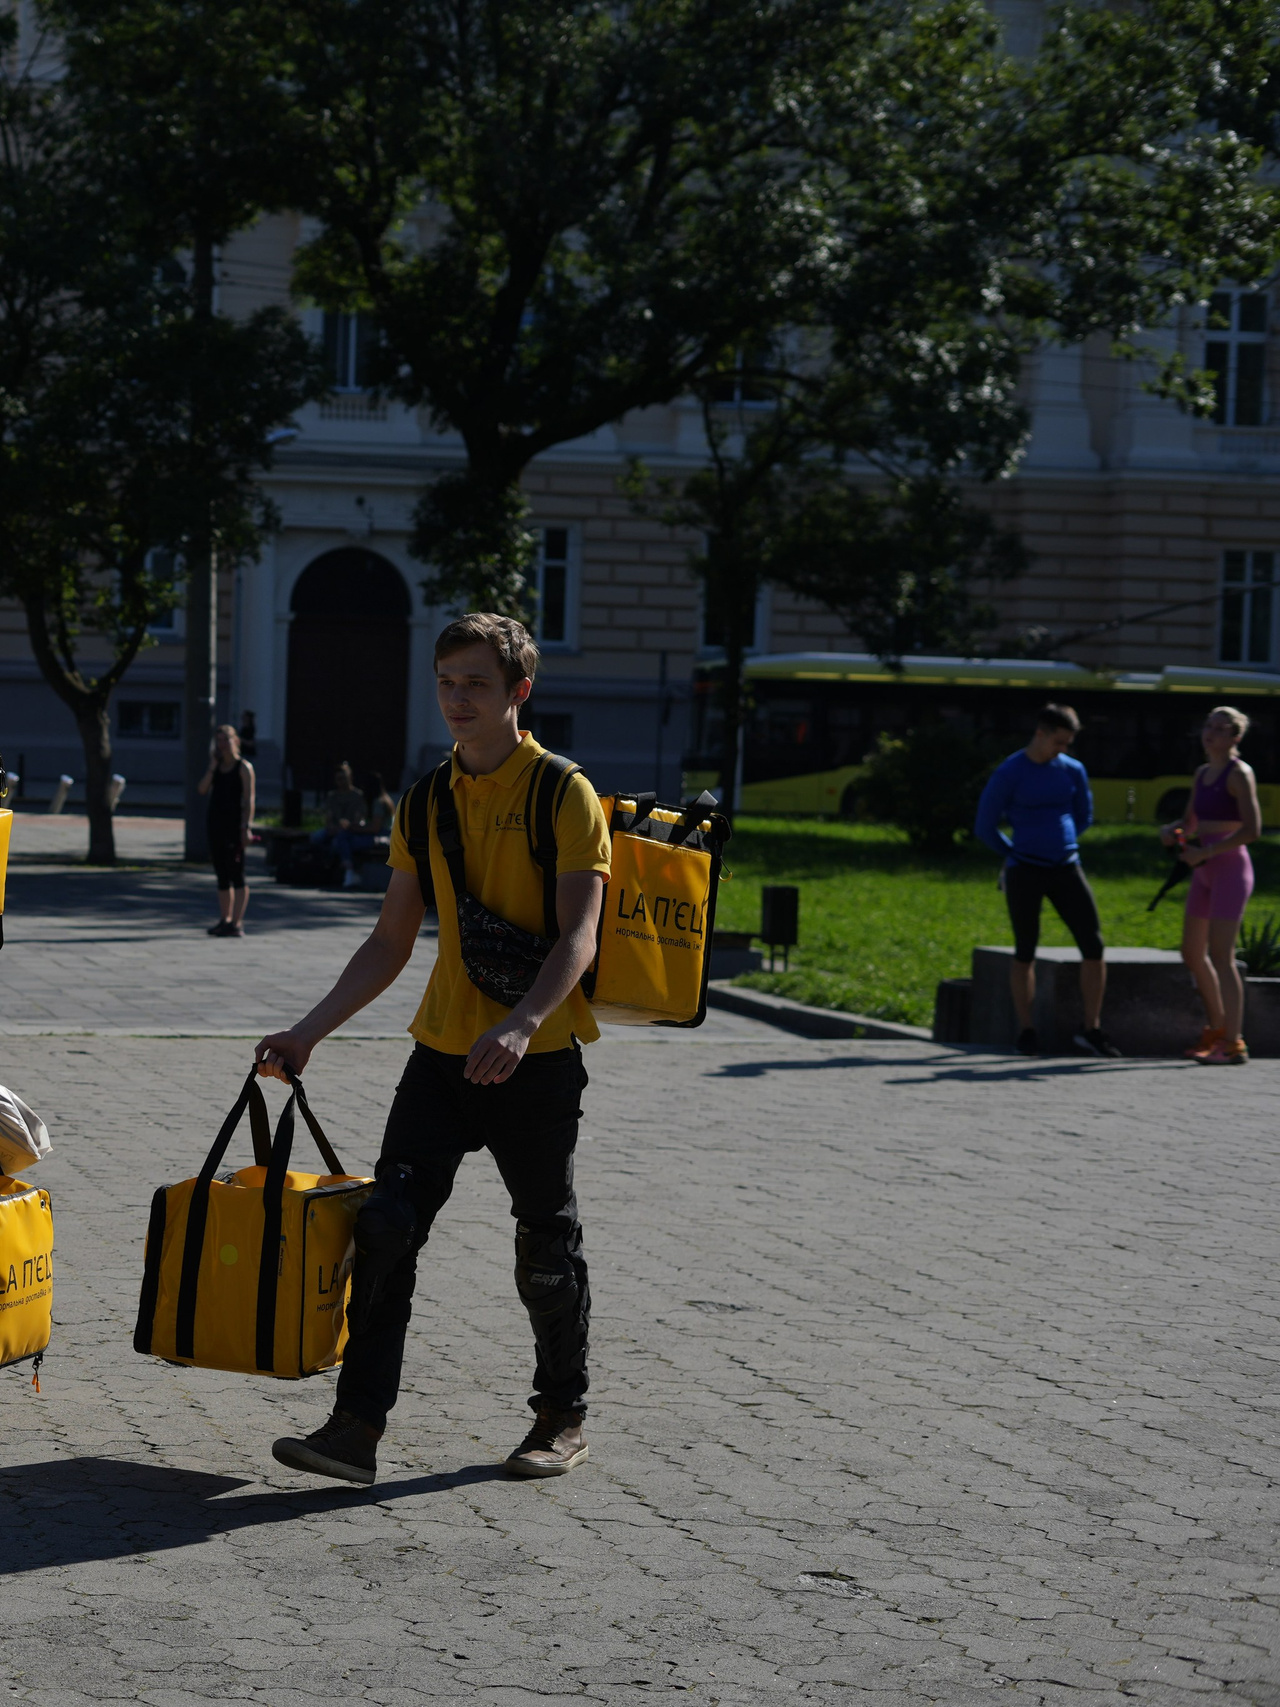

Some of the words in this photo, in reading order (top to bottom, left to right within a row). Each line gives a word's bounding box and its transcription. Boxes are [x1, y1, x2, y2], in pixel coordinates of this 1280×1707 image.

[618, 888, 647, 923] LA
[615, 927, 655, 942] нормальна
[656, 934, 691, 950] доставка
[318, 1261, 339, 1295] LA
